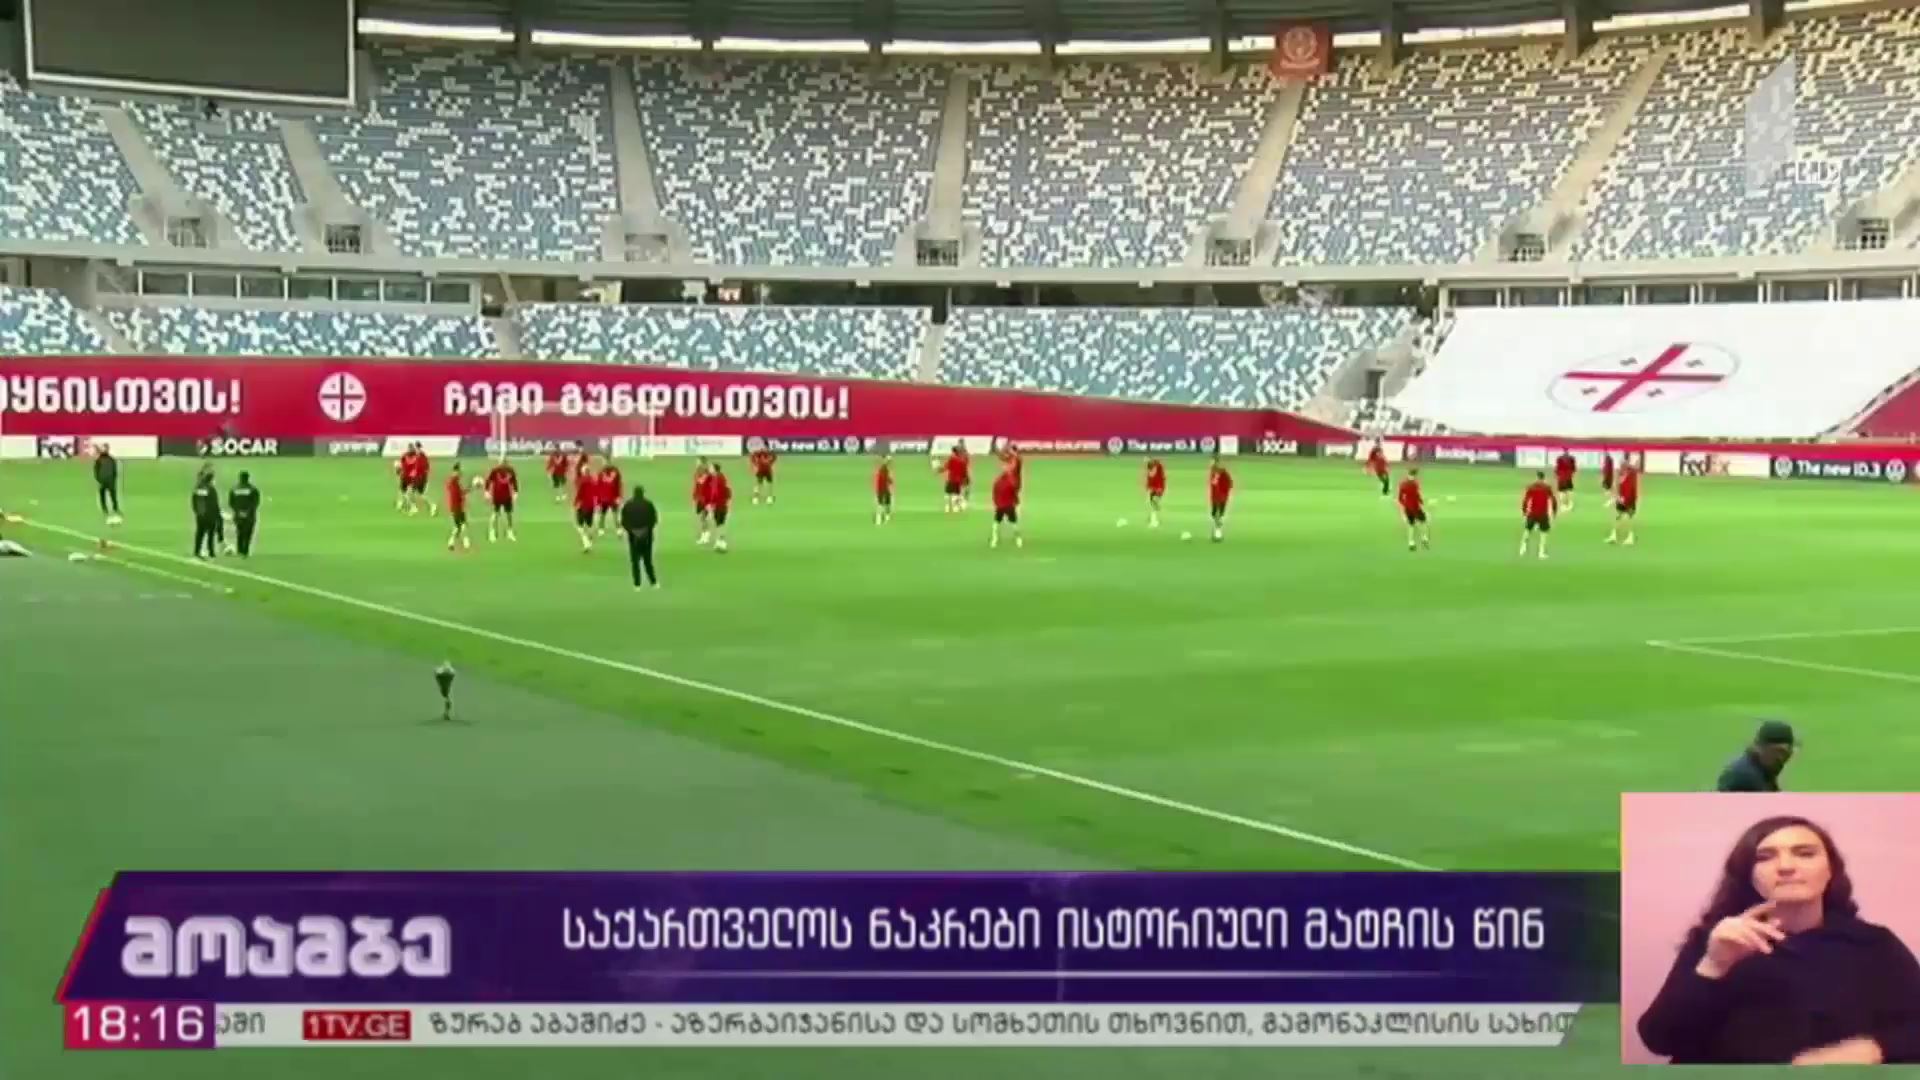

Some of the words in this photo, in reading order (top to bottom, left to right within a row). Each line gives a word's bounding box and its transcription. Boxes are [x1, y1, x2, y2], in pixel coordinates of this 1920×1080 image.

[444, 381, 544, 415] ჩემი
[560, 382, 849, 420] გუნდისთვის!
[211, 438, 278, 455] SOCAR
[1797, 459, 1820, 475] The
[1822, 463, 1851, 476] new
[1853, 461, 1880, 477] ID.3
